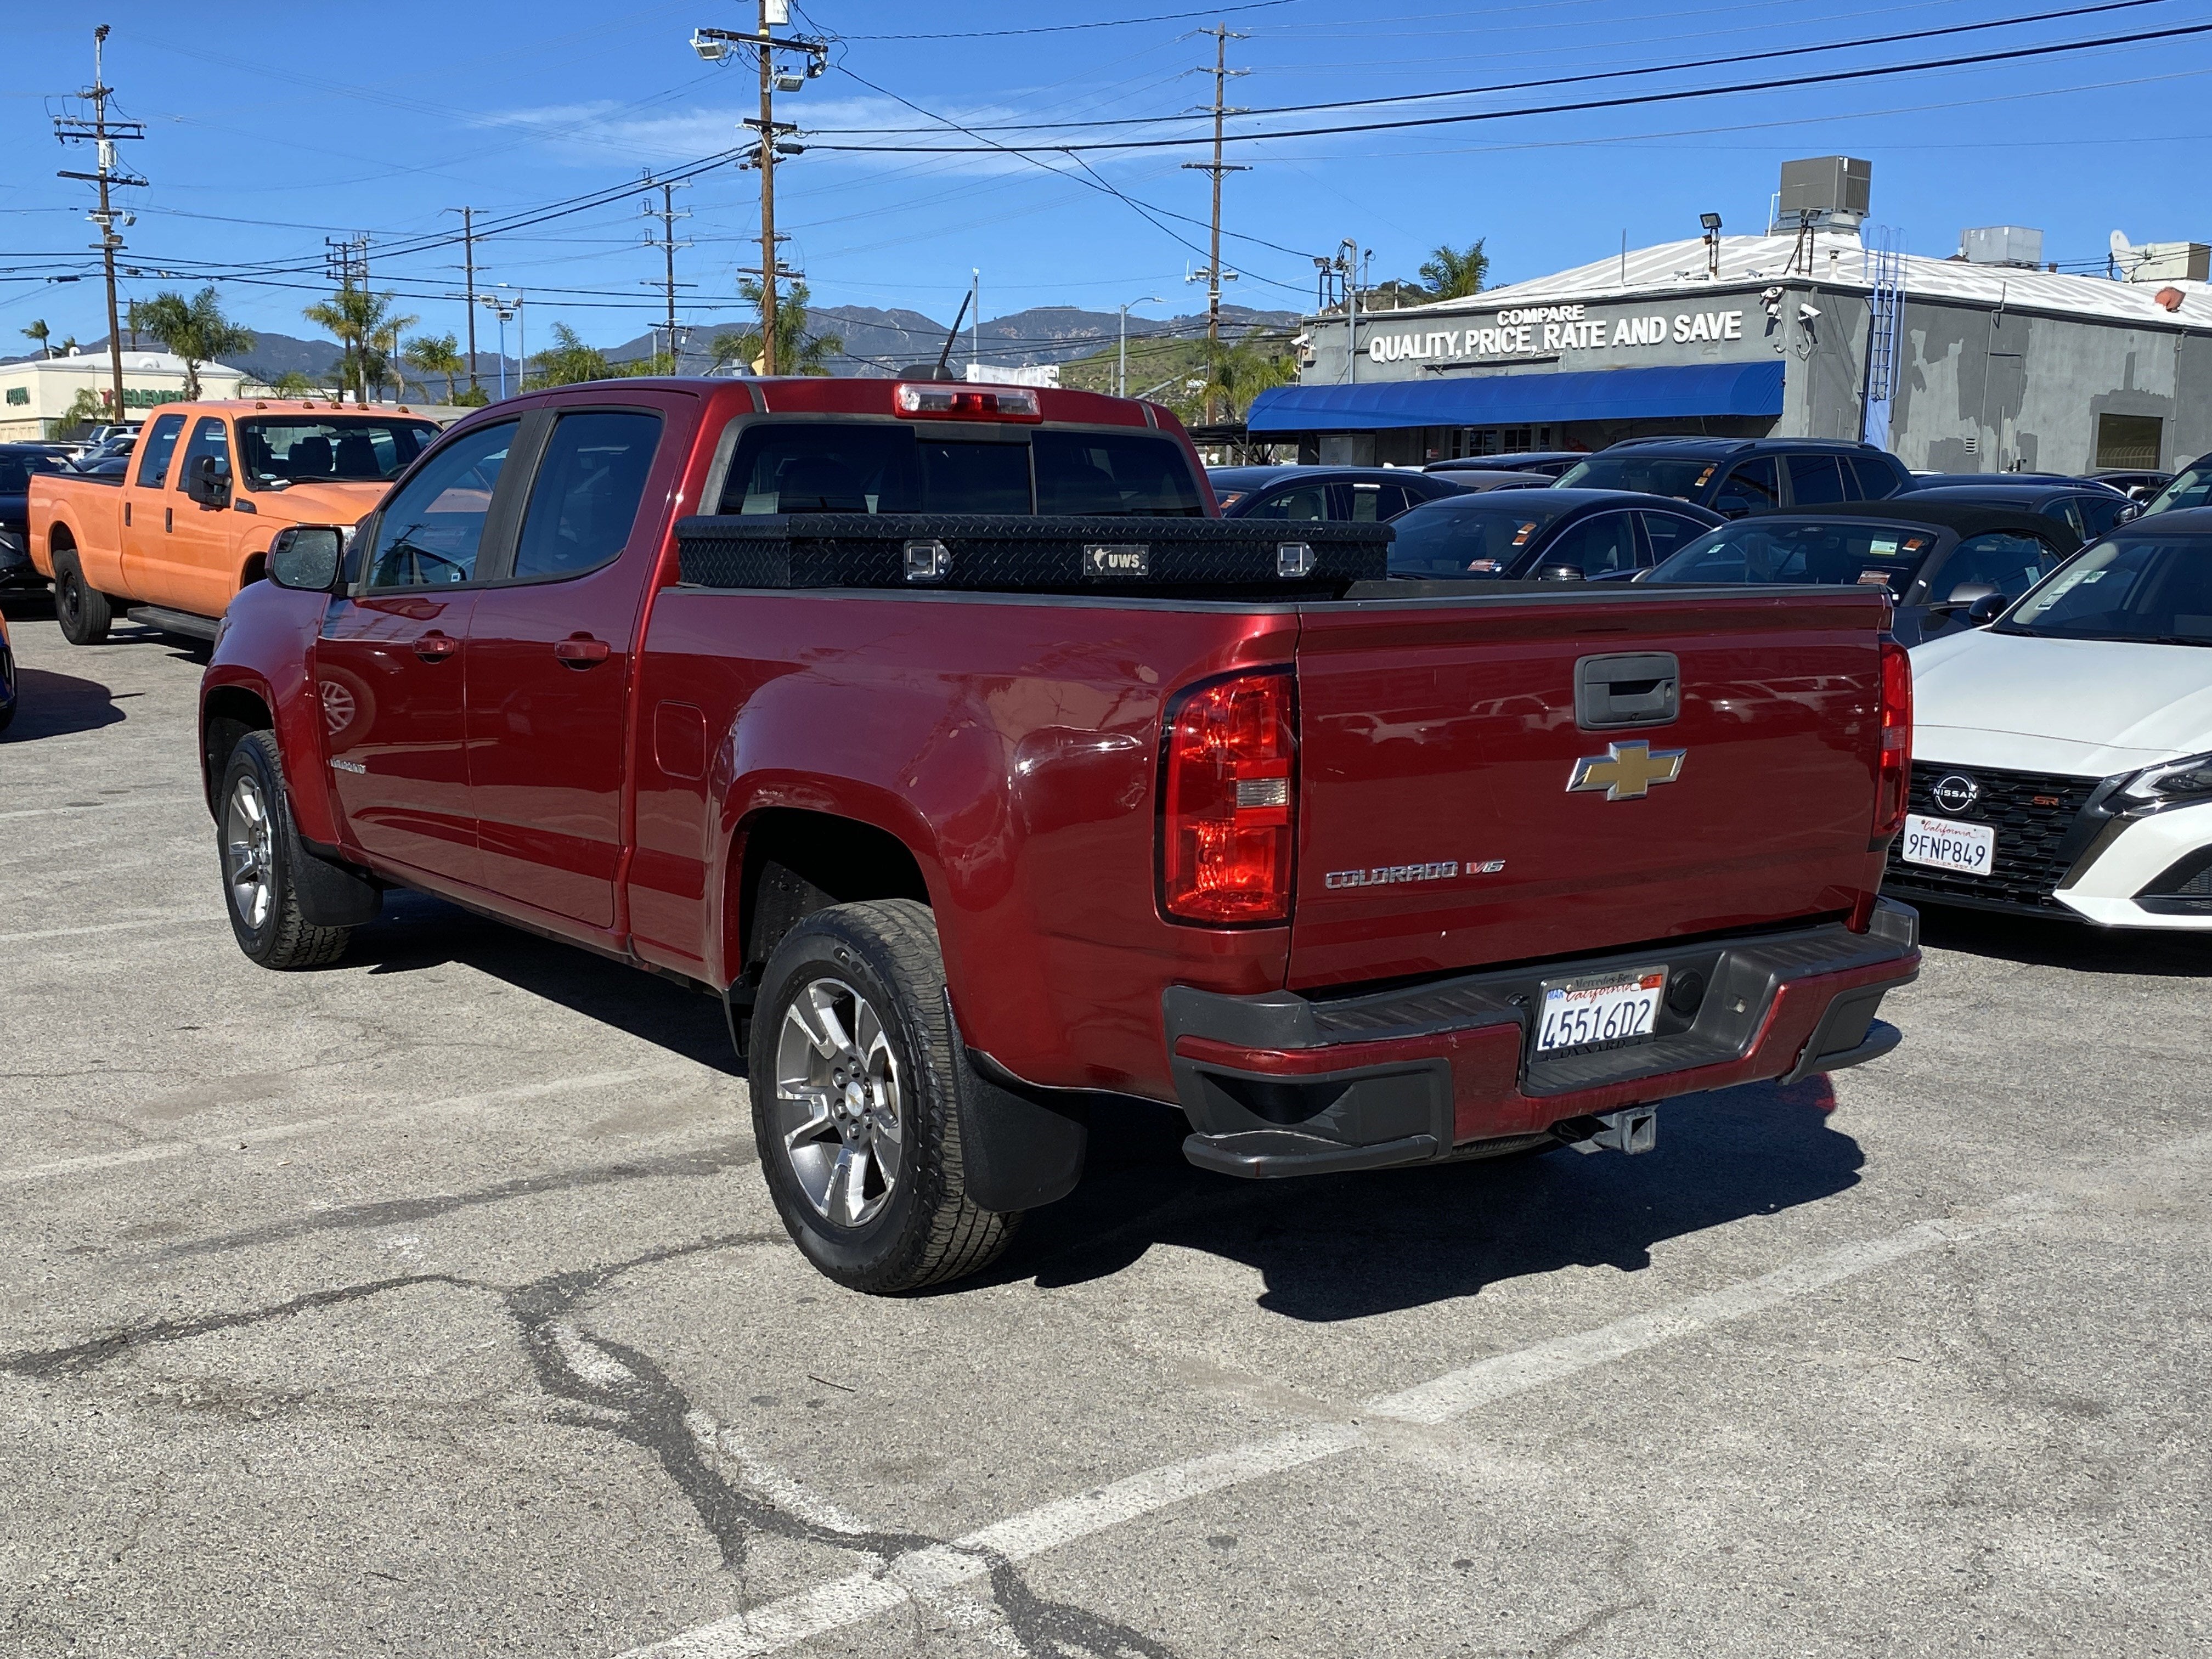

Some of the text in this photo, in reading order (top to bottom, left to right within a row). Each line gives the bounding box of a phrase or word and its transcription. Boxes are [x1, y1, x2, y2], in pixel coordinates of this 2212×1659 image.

[1497, 305, 1585, 326] COMPARE
[1369, 311, 1742, 363] QUALITY, PRICE, RATE AND SAVE
[1109, 554, 1139, 568] UWS
[1933, 788, 1977, 799] NISSAN
[2033, 796, 2058, 806] SR
[1923, 821, 1977, 838] California
[1909, 833, 1985, 866] 9FNP849
[1325, 860, 1505, 889] COLORADO V6
[1575, 973, 1638, 988] Mercedes-Benz
[1542, 998, 1650, 1049] 45516D2
